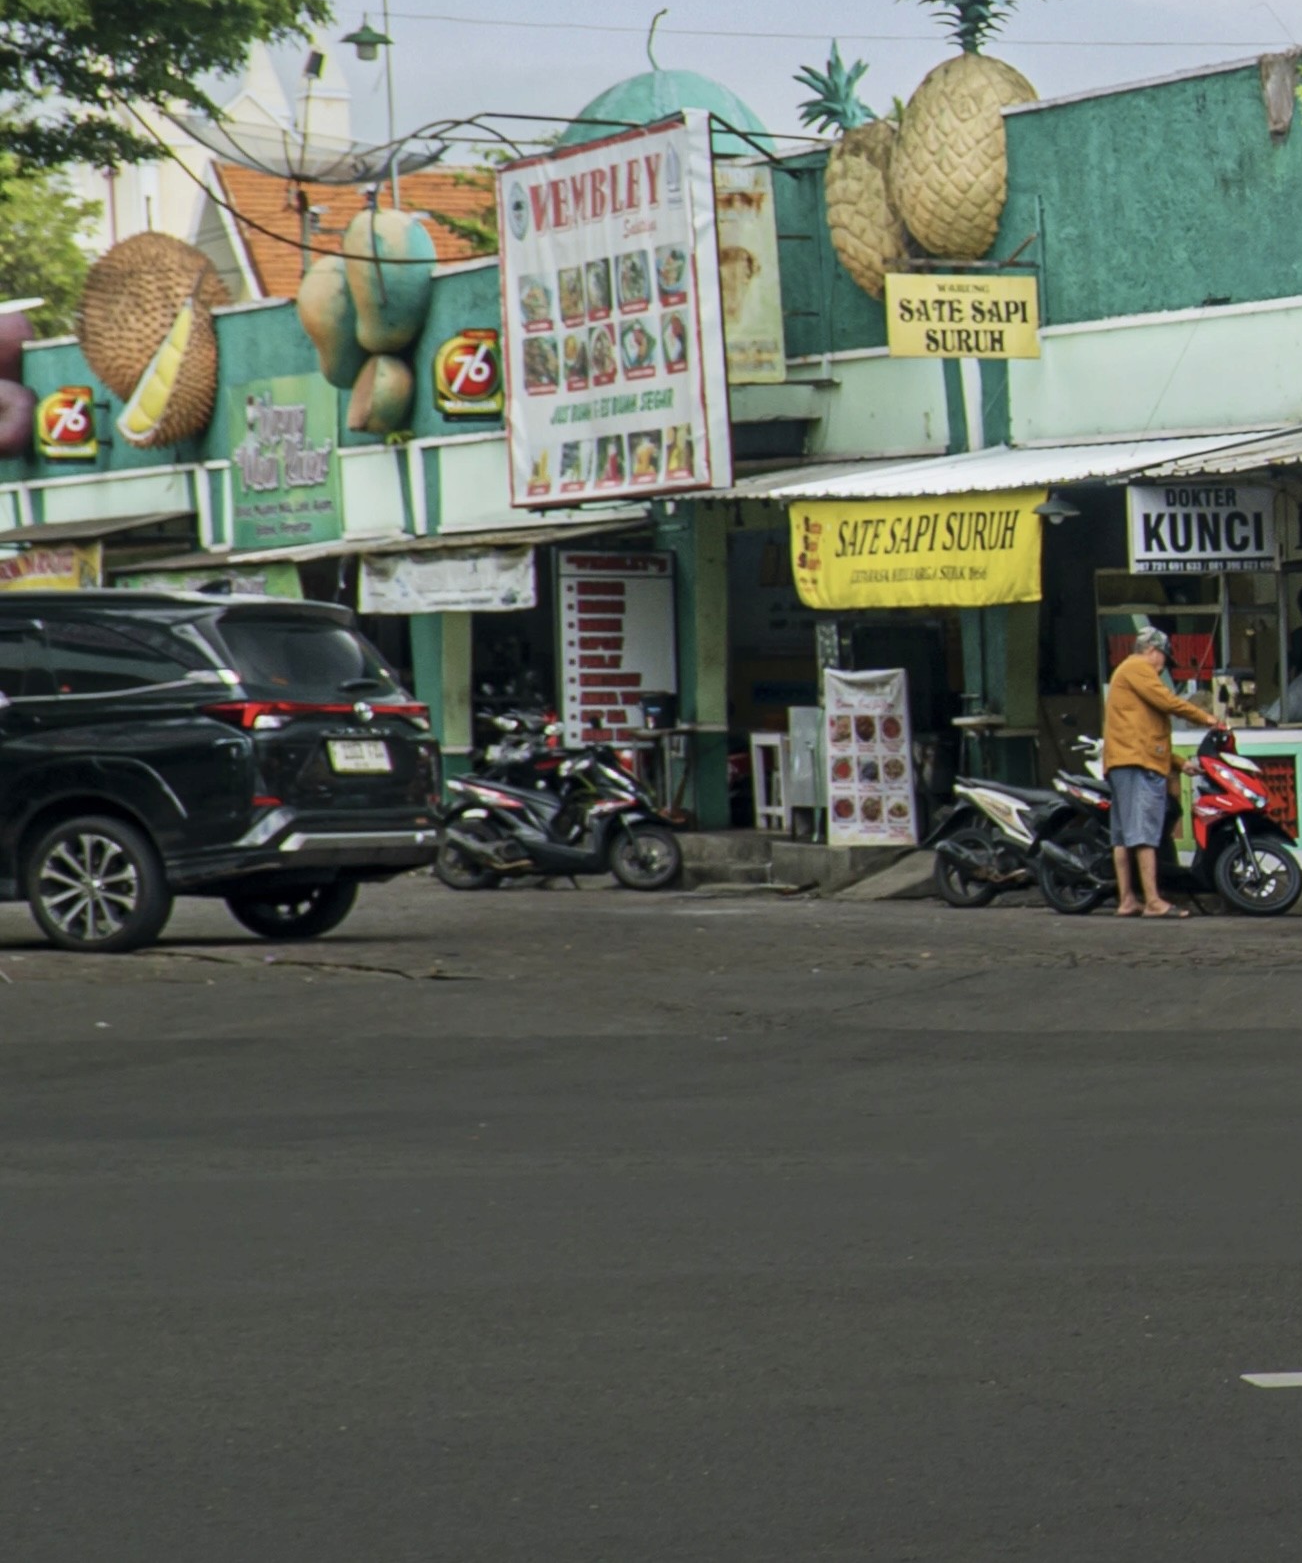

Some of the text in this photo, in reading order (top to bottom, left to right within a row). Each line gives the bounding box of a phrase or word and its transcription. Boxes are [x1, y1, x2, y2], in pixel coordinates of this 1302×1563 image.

[899, 298, 1029, 324] SATE SAPI
[925, 329, 1005, 353] SURUH
[451, 343, 491, 393] 76
[50, 398, 87, 440] 76
[1165, 488, 1237, 507] DOKTER
[835, 518, 887, 558] SATE
[884, 513, 939, 554] SAPI
[941, 509, 1021, 552] SURUH
[1143, 511, 1265, 553] KUNCI
